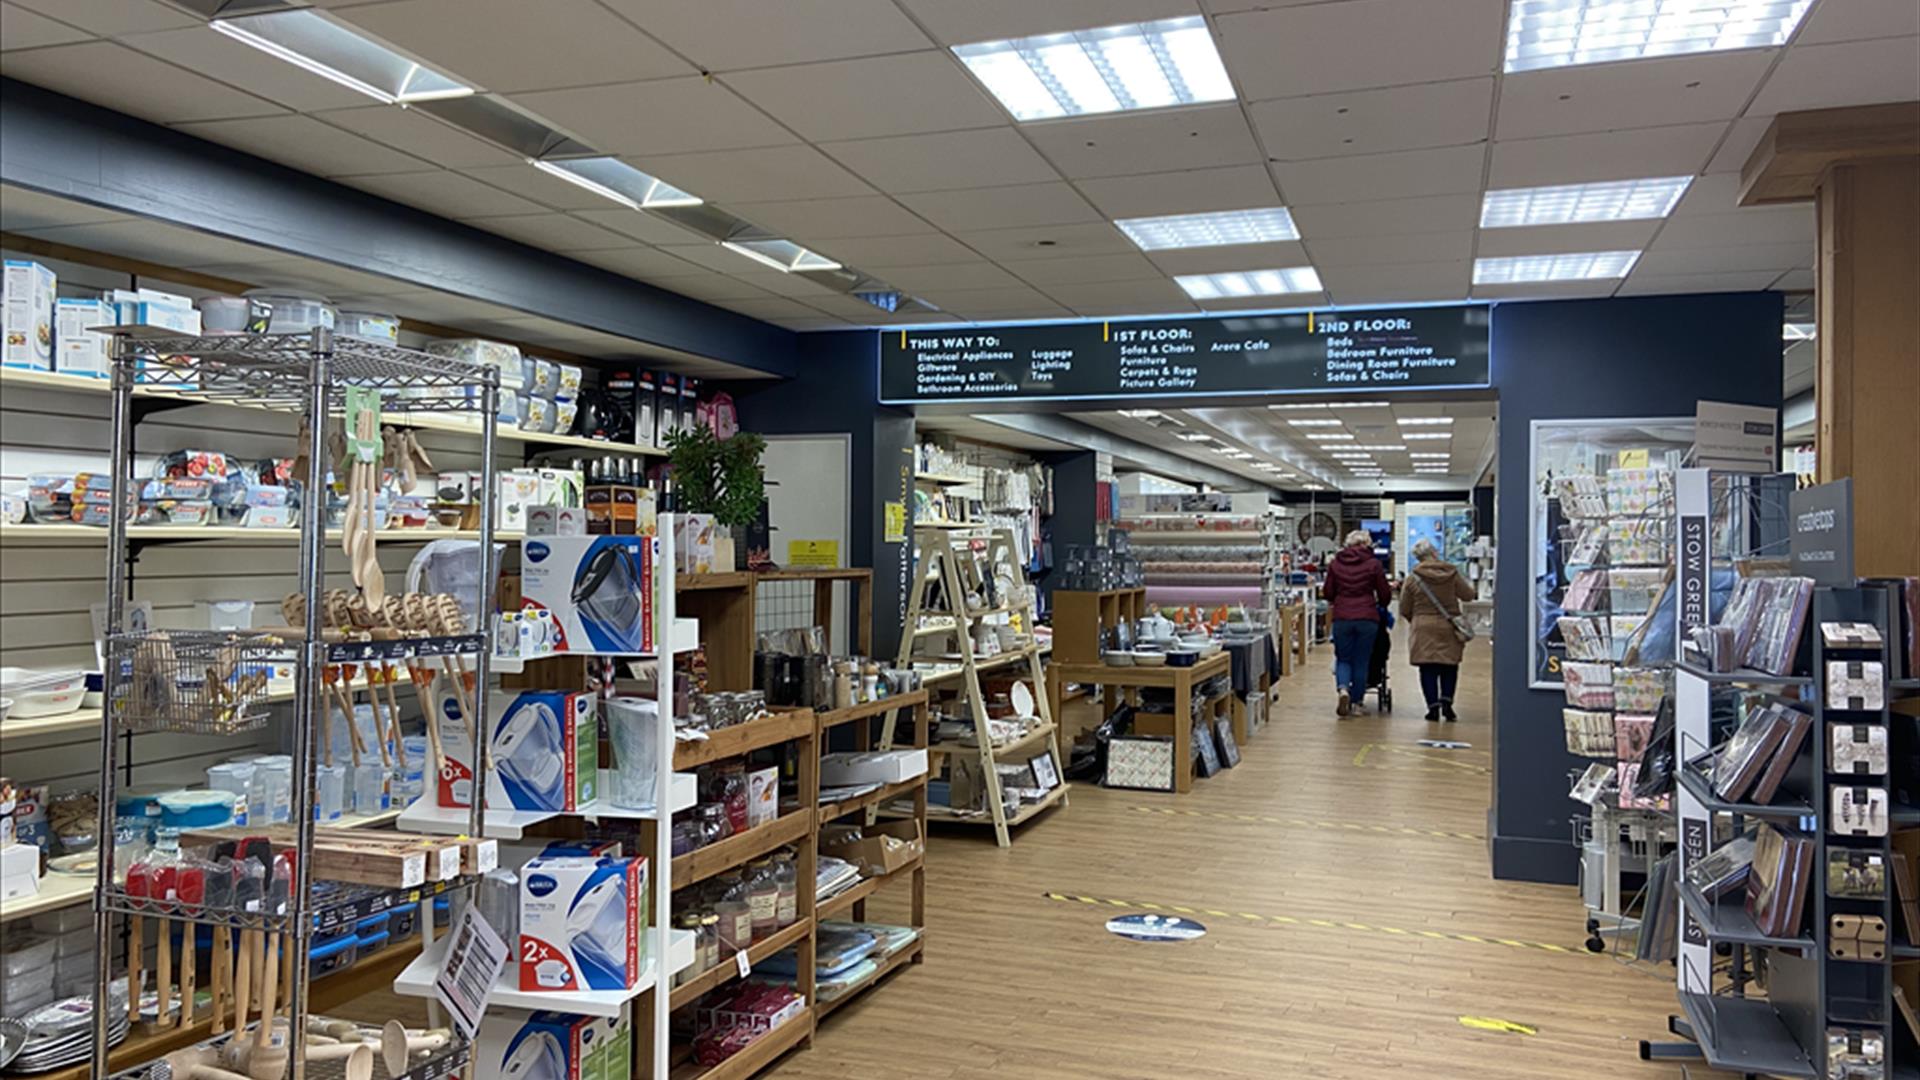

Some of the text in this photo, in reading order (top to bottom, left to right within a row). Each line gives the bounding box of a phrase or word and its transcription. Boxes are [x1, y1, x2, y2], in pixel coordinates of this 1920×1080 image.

[1318, 319, 1411, 333] 2ND FLOOR:
[1113, 329, 1192, 342] 1ST FLOOR:
[910, 337, 1000, 349] THIS WAY TO:
[1327, 337, 1353, 347] Beds
[1032, 350, 1073, 360] Luggage
[1120, 343, 1195, 355] Sofas & Chairs
[1327, 346, 1433, 359] Bedroom Furniture
[917, 350, 1013, 362] Electrical Appliances
[1120, 356, 1167, 366] Furniture
[917, 363, 957, 373] Giftware
[1032, 360, 1072, 371] Lighting
[1327, 358, 1456, 371] Dining Room Furniture
[917, 372, 996, 384] Gardening & DIY
[1031, 370, 1053, 381] Toys
[1120, 366, 1197, 378] Carpets & Rugs
[1327, 370, 1409, 382] Sofas & Chairs
[917, 383, 1018, 394] Bathroom Accessories
[1120, 377, 1196, 389] Picture Gallery
[900, 535, 909, 628] Patterson
[1686, 523, 1702, 634] STOW GREEN
[1548, 655, 1560, 673] S
[523, 941, 549, 962] 2x
